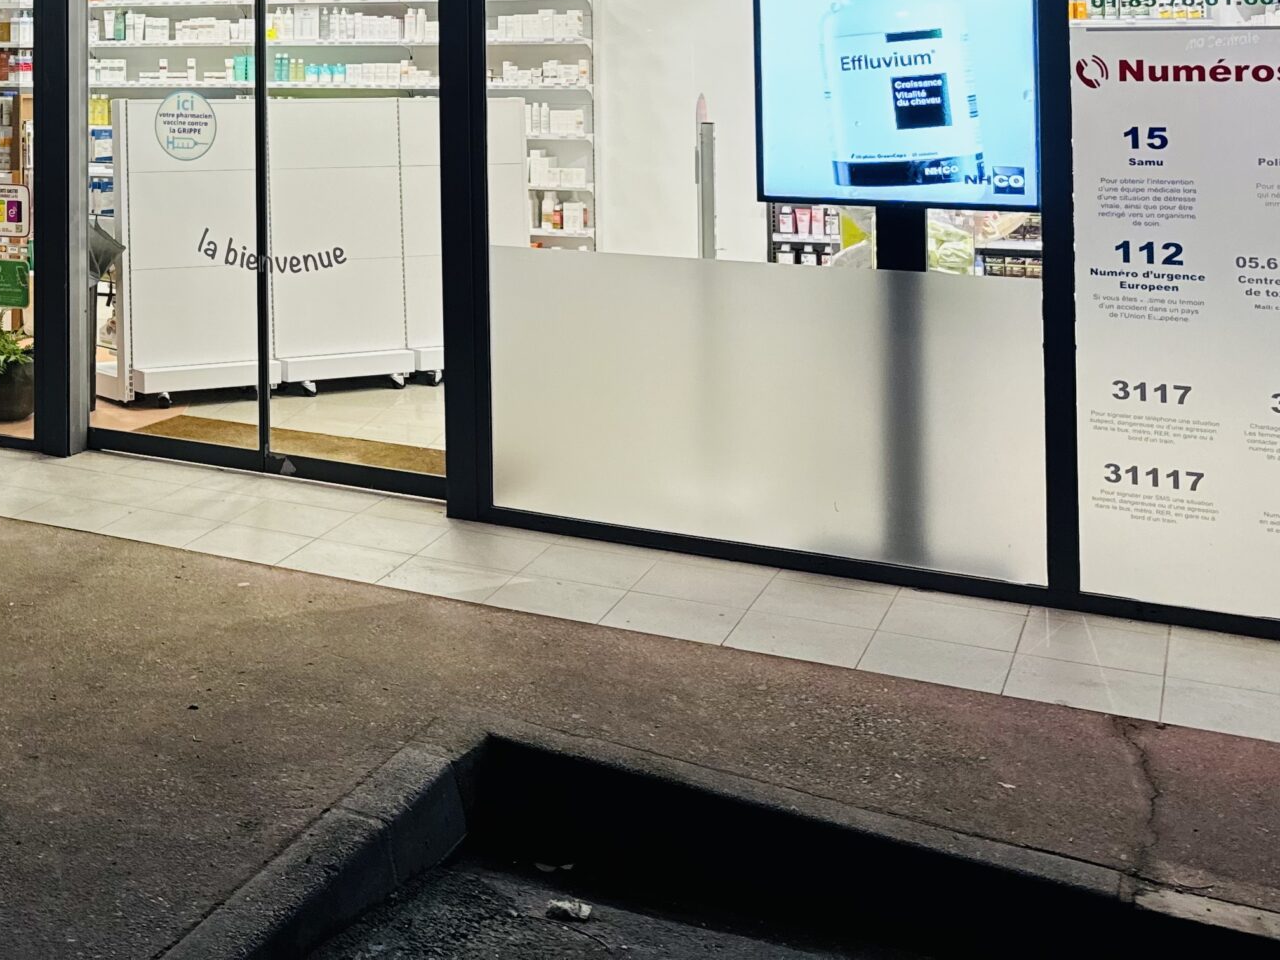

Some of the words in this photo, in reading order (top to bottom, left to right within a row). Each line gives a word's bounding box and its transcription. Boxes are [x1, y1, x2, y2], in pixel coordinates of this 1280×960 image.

[840, 52, 932, 71] Effluvium
[1119, 58, 1280, 82] Numéro
[894, 79, 942, 89] Croissance
[177, 95, 194, 111] ici
[896, 98, 909, 107] du
[910, 97, 941, 106] cheveu
[1123, 127, 1169, 149] 15
[1128, 158, 1163, 167] Samu
[198, 227, 217, 259] la
[225, 237, 347, 273] bienvenue
[1115, 240, 1183, 266] 112
[1142, 270, 1205, 281] d'urgence
[1245, 287, 1261, 296] de
[1265, 289, 1280, 297] to
[1112, 380, 1192, 404] 3117
[1104, 463, 1204, 491] 31117
